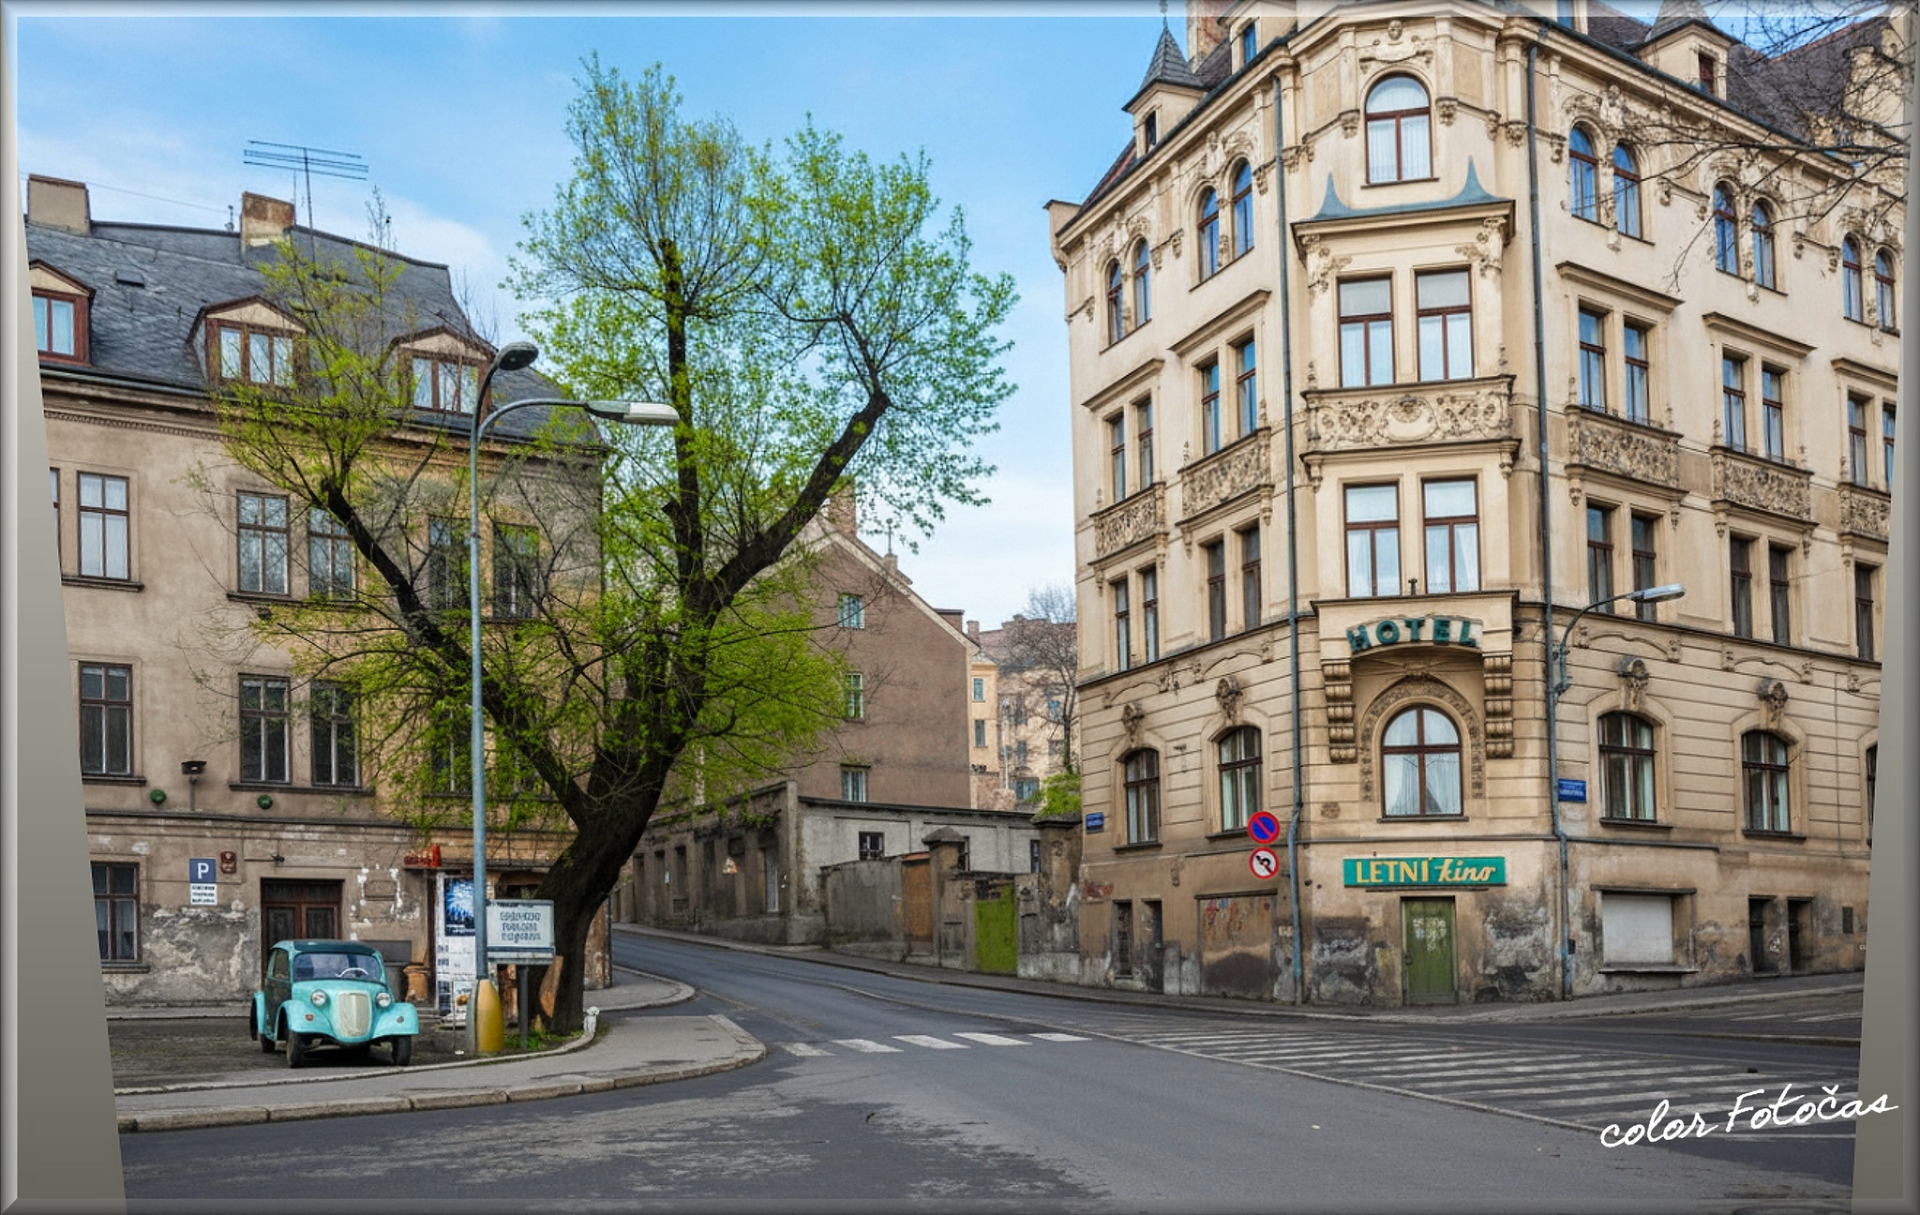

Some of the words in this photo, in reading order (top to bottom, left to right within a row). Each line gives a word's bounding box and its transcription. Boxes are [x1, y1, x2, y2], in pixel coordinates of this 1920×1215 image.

[1346, 616, 1477, 655] HOTEL
[197, 862, 210, 880] P
[1356, 857, 1432, 883] LETNÍ
[1434, 858, 1496, 882] kino
